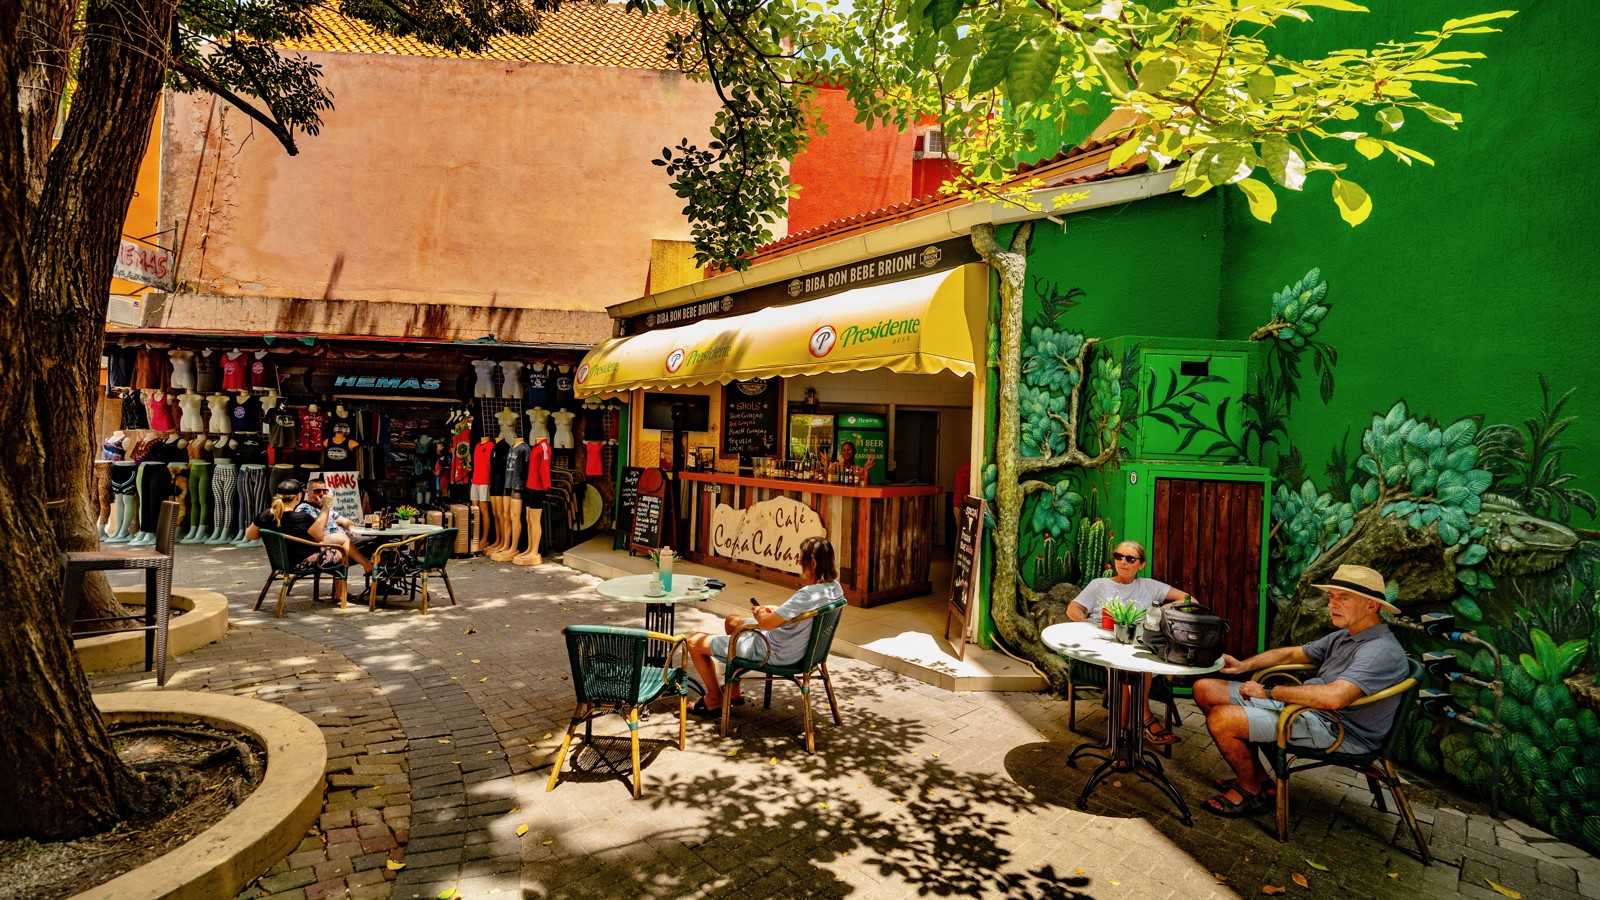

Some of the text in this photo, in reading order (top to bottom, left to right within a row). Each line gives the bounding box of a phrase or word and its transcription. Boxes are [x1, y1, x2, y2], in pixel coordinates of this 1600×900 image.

[805, 253, 917, 293] BIBA BON BEBE BRION!
[656, 312, 669, 325] BIBA
[670, 309, 682, 322] BON
[682, 305, 697, 320] BEBE
[698, 300, 720, 316] BRION!
[840, 318, 920, 348] Presidente
[892, 336, 911, 345] BEER
[686, 345, 731, 367] Presidente
[334, 375, 442, 390] HEMAS
[865, 439, 884, 448] BEER
[326, 472, 356, 490] HEMAS
[775, 505, 806, 533] Café
